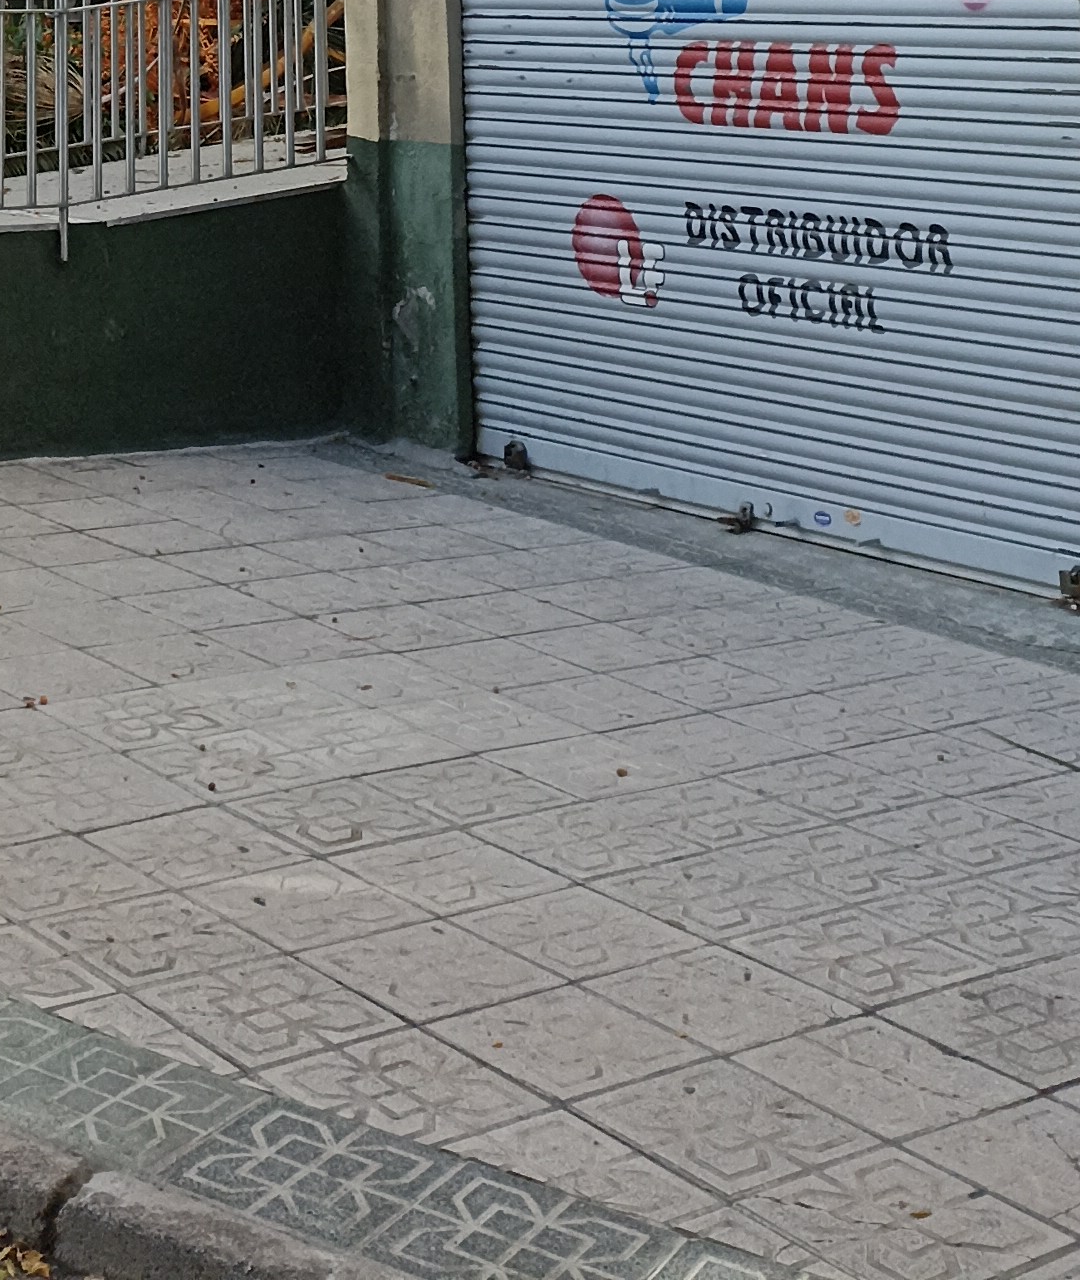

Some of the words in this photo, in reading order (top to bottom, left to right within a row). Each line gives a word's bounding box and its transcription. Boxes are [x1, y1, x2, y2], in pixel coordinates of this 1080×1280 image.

[674, 40, 901, 136] CHANS
[684, 201, 954, 275] DISTRIBUIDOR
[738, 273, 887, 334] OFICIAL
